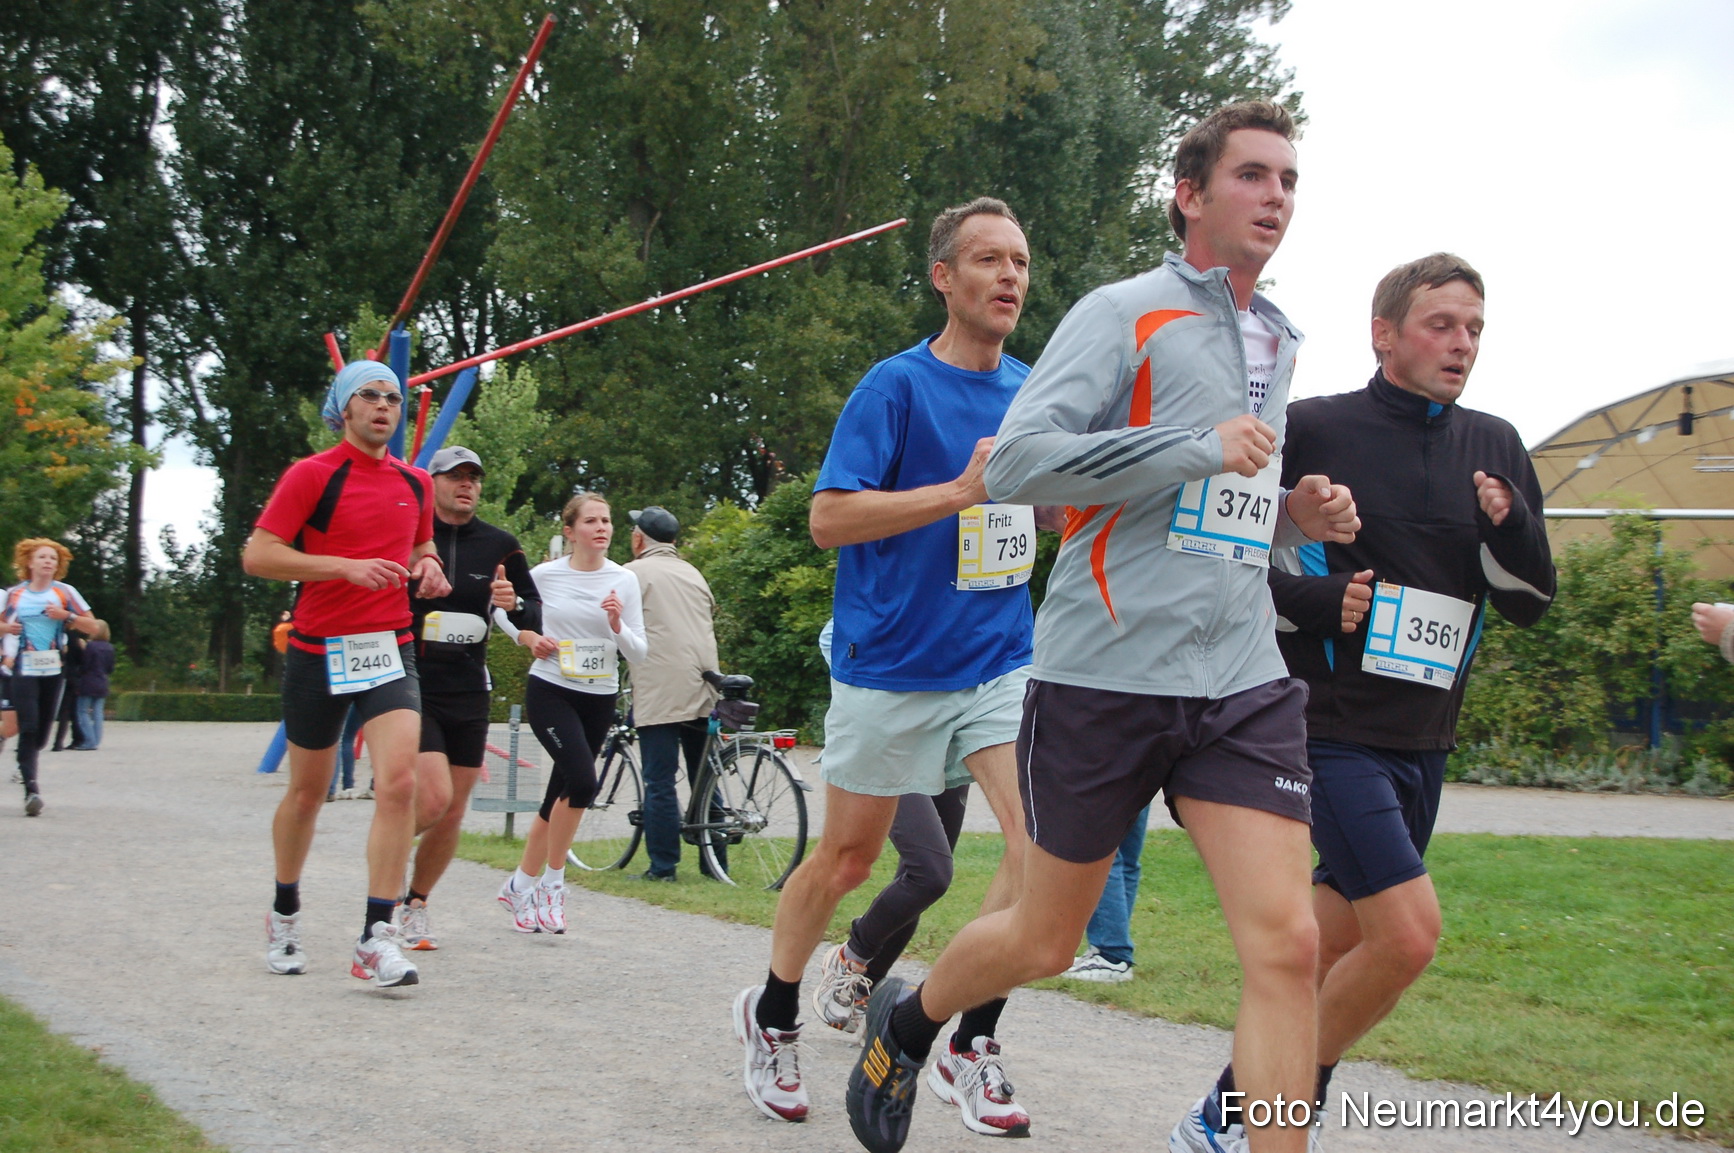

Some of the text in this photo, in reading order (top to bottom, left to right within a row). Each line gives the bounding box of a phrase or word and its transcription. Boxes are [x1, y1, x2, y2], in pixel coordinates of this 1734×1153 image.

[1216, 488, 1271, 526] 3747
[988, 512, 1012, 529] Fritz
[963, 539, 970, 551] B
[996, 533, 1027, 561] 739
[1407, 616, 1460, 652] 3561
[348, 640, 379, 651] Thomas
[351, 653, 392, 672] 2440
[581, 657, 605, 670] 481
[1274, 776, 1309, 796] JAKO
